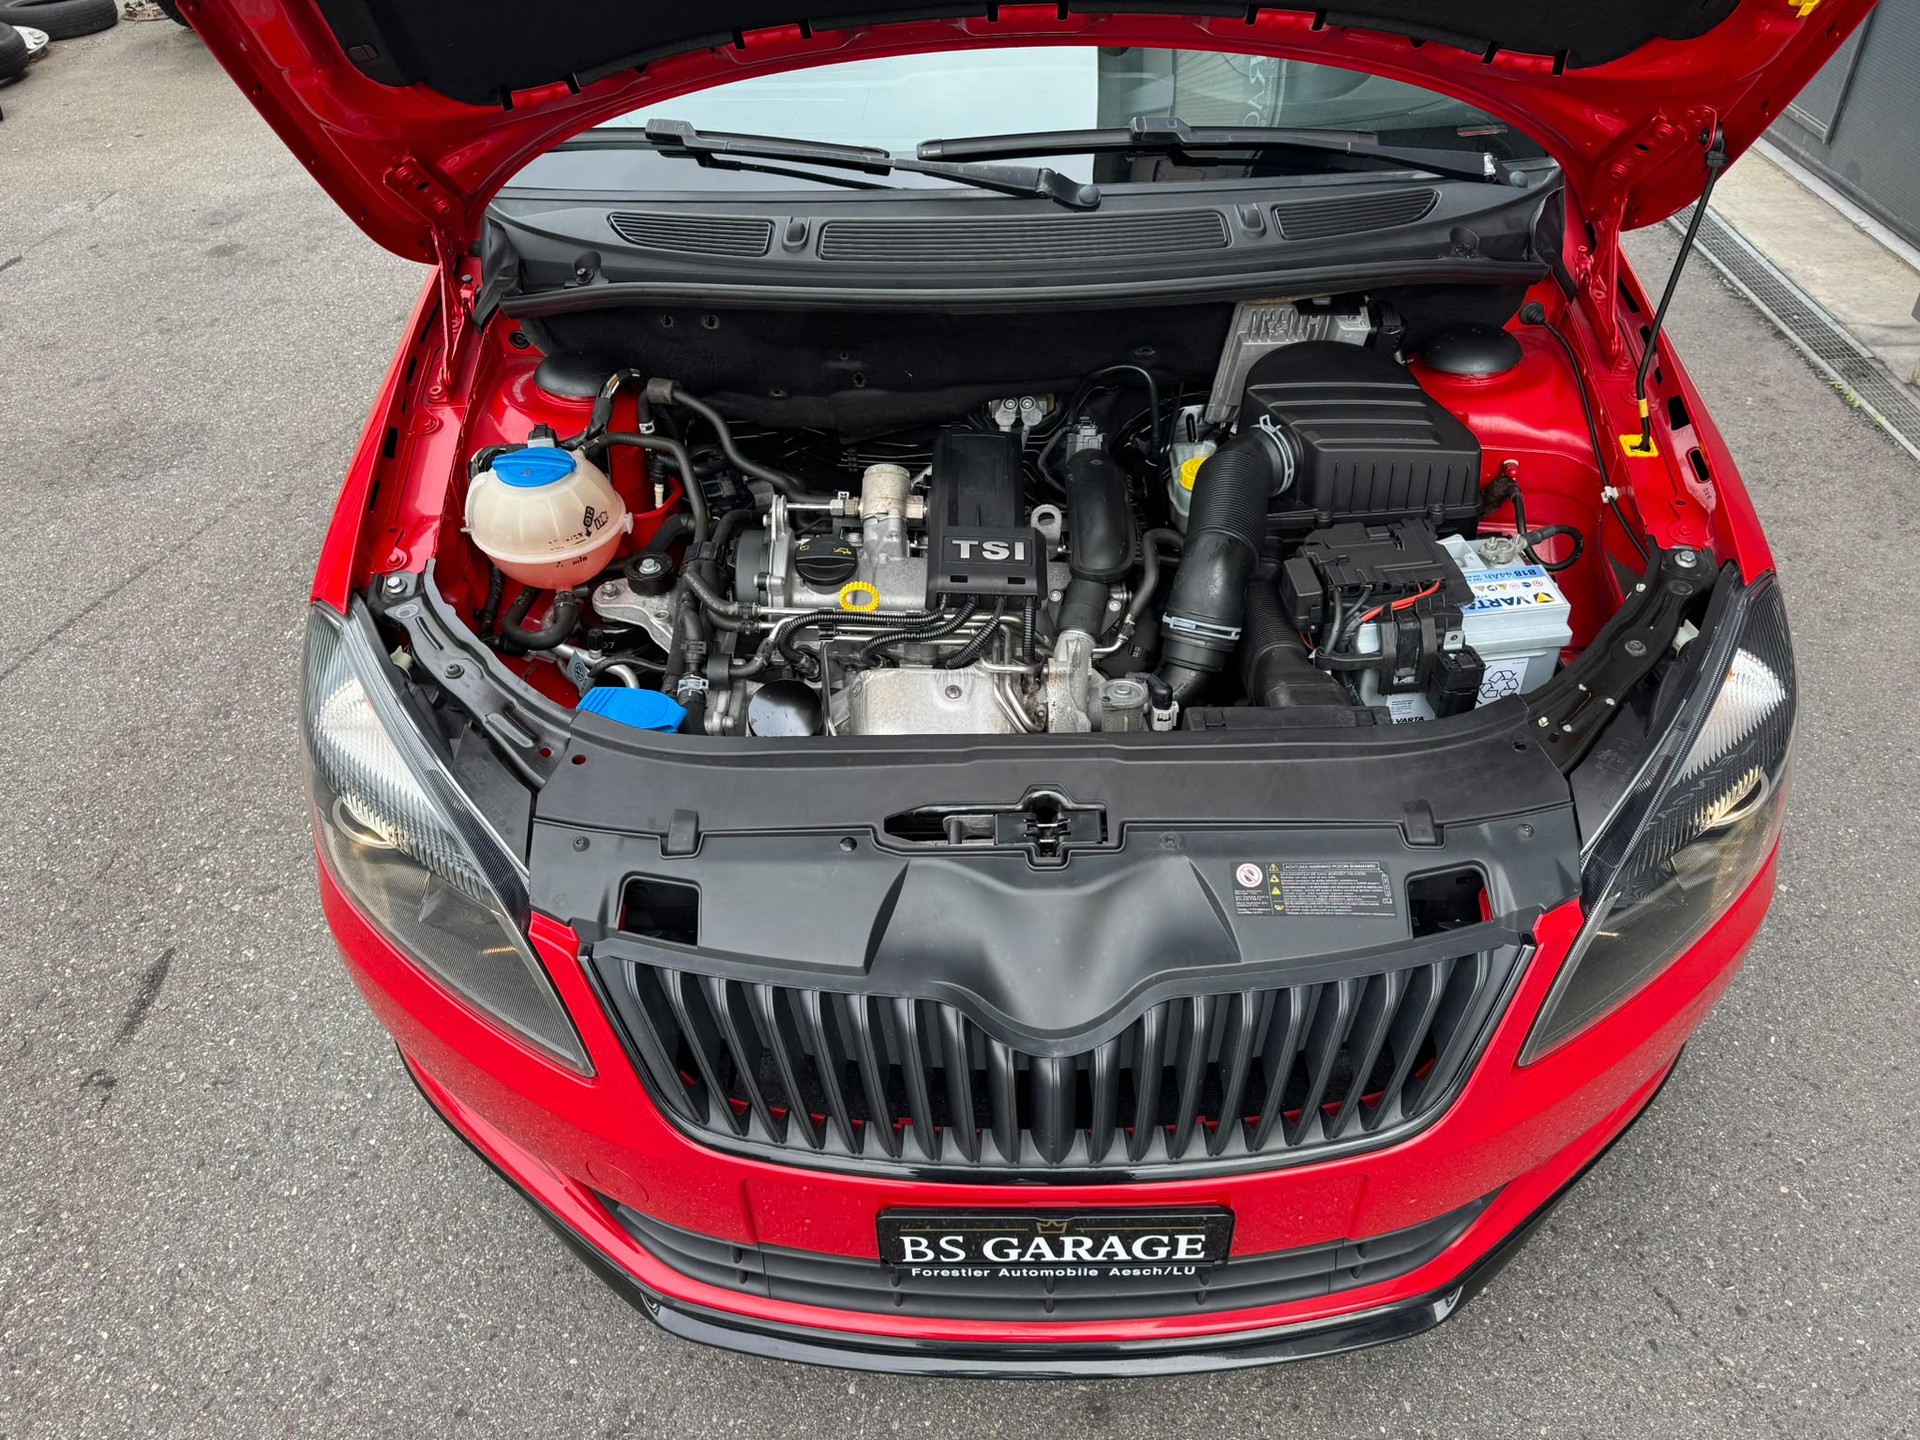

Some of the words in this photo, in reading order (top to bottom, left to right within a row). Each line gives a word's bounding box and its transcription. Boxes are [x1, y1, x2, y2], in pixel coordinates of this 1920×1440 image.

[952, 540, 1024, 560] TSI
[1484, 572, 1512, 580] 44Ah
[1514, 569, 1537, 577] B18
[900, 1236, 966, 1262] BS
[983, 1235, 1206, 1262] GARAGE
[912, 1268, 990, 1277] Forestier
[999, 1267, 1099, 1277] Automobile
[1109, 1266, 1196, 1276] Aesch/LU
